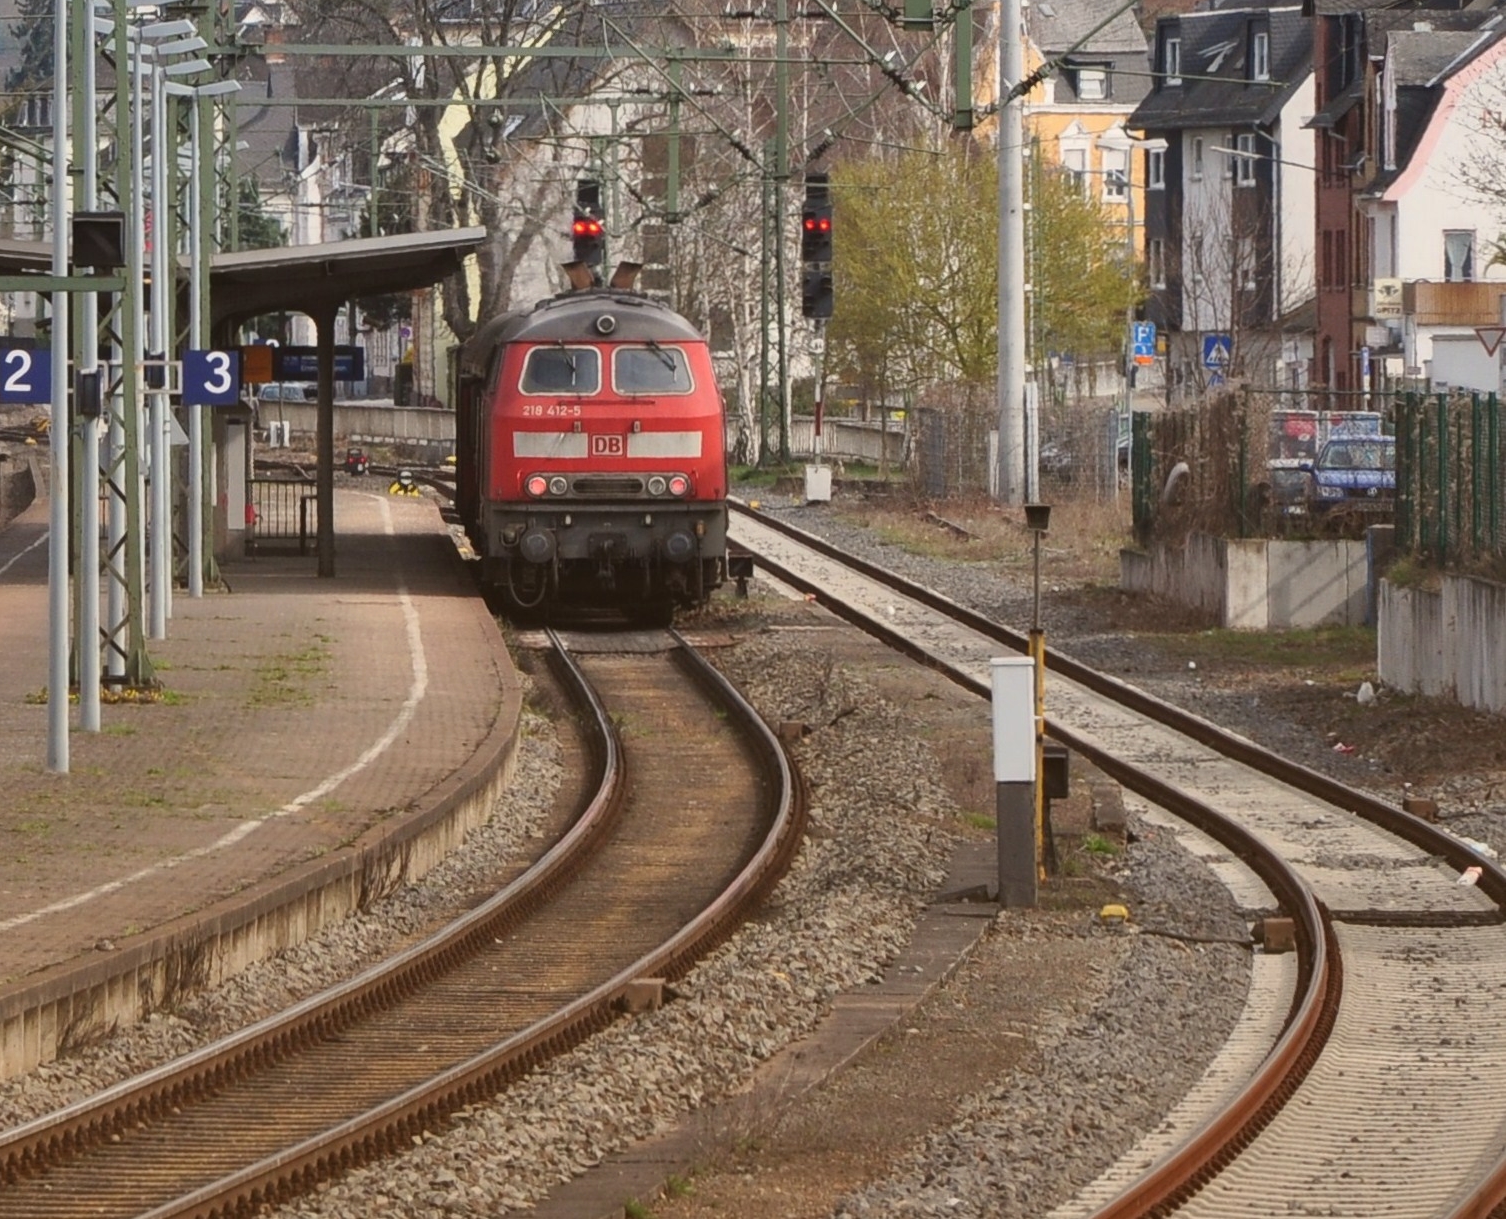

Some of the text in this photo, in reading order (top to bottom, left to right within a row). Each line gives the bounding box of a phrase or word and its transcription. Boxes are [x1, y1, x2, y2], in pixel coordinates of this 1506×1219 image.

[4, 349, 31, 391] 2
[204, 351, 231, 394] 3
[523, 405, 581, 416] 218 412-5
[594, 436, 621, 453] DB
